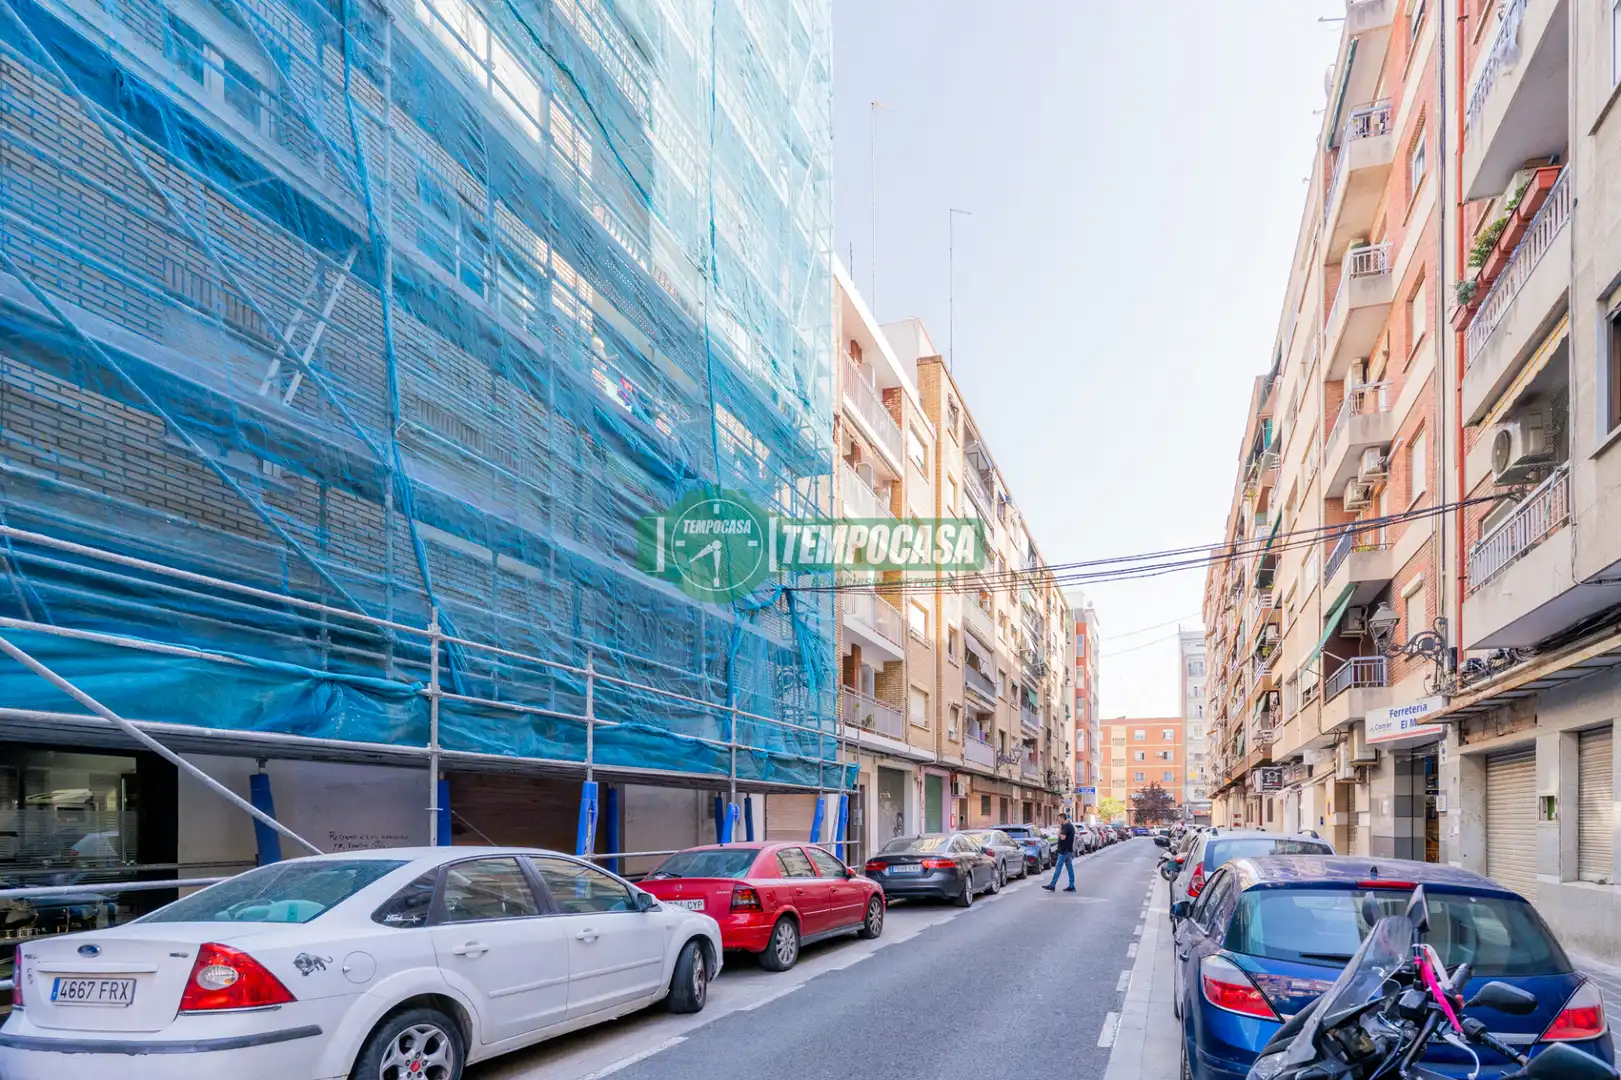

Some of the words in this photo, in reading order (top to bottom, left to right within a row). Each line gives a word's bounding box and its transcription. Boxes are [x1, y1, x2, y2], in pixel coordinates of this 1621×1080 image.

[1401, 719, 1408, 730] El
[687, 900, 703, 909] CYP
[60, 981, 95, 999] 4667
[100, 981, 129, 1000] FRX
